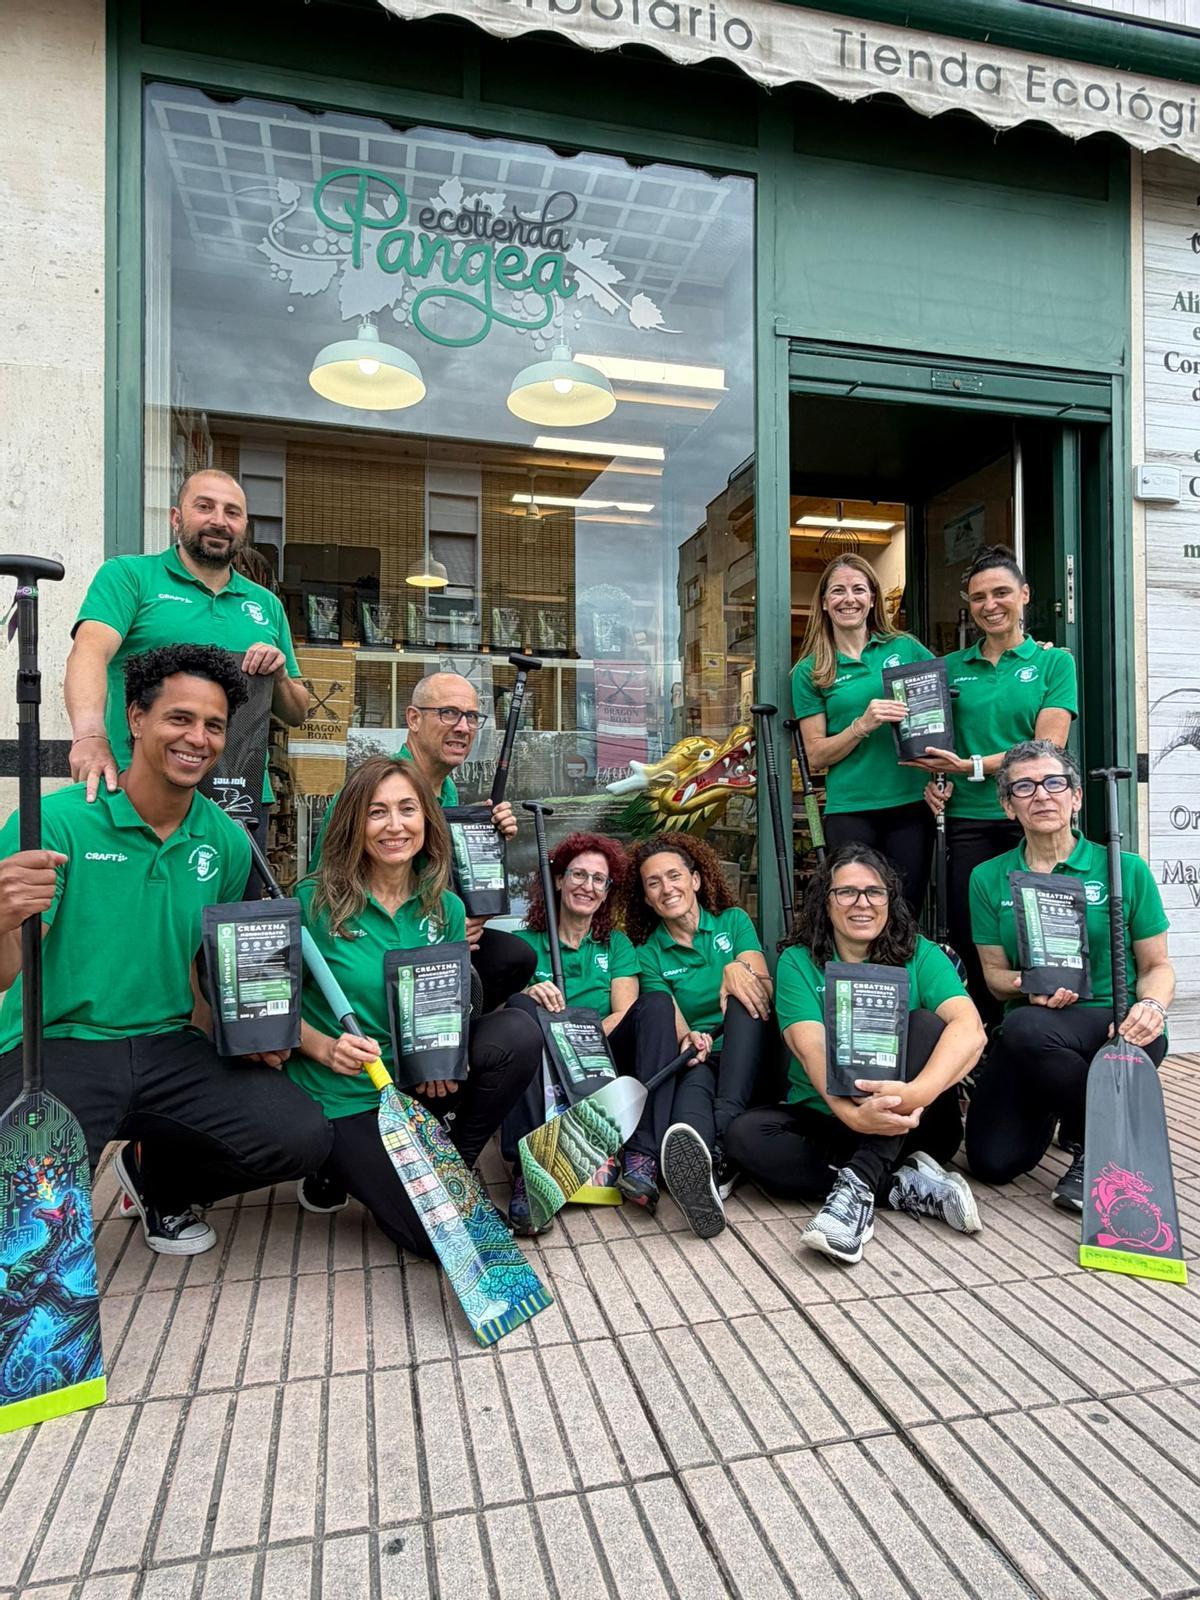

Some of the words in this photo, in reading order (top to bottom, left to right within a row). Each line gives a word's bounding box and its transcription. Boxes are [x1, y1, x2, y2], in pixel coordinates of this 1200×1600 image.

[833, 28, 1002, 96] Tienda
[1026, 64, 1196, 138] Ecológi
[418, 190, 578, 251] ecotienda
[313, 167, 579, 348] Pangea
[904, 673, 937, 684] CREATINA
[300, 723, 342, 733] DRAGON
[307, 732, 335, 740] BOAT
[213, 776, 246, 788] hornet
[85, 852, 119, 862] CRAFT
[1162, 859, 1200, 885] Ma
[1037, 891, 1074, 901] CREATINA
[237, 923, 286, 932] CREATINA
[415, 963, 458, 974] CREATINA
[853, 983, 896, 992] CREATINA
